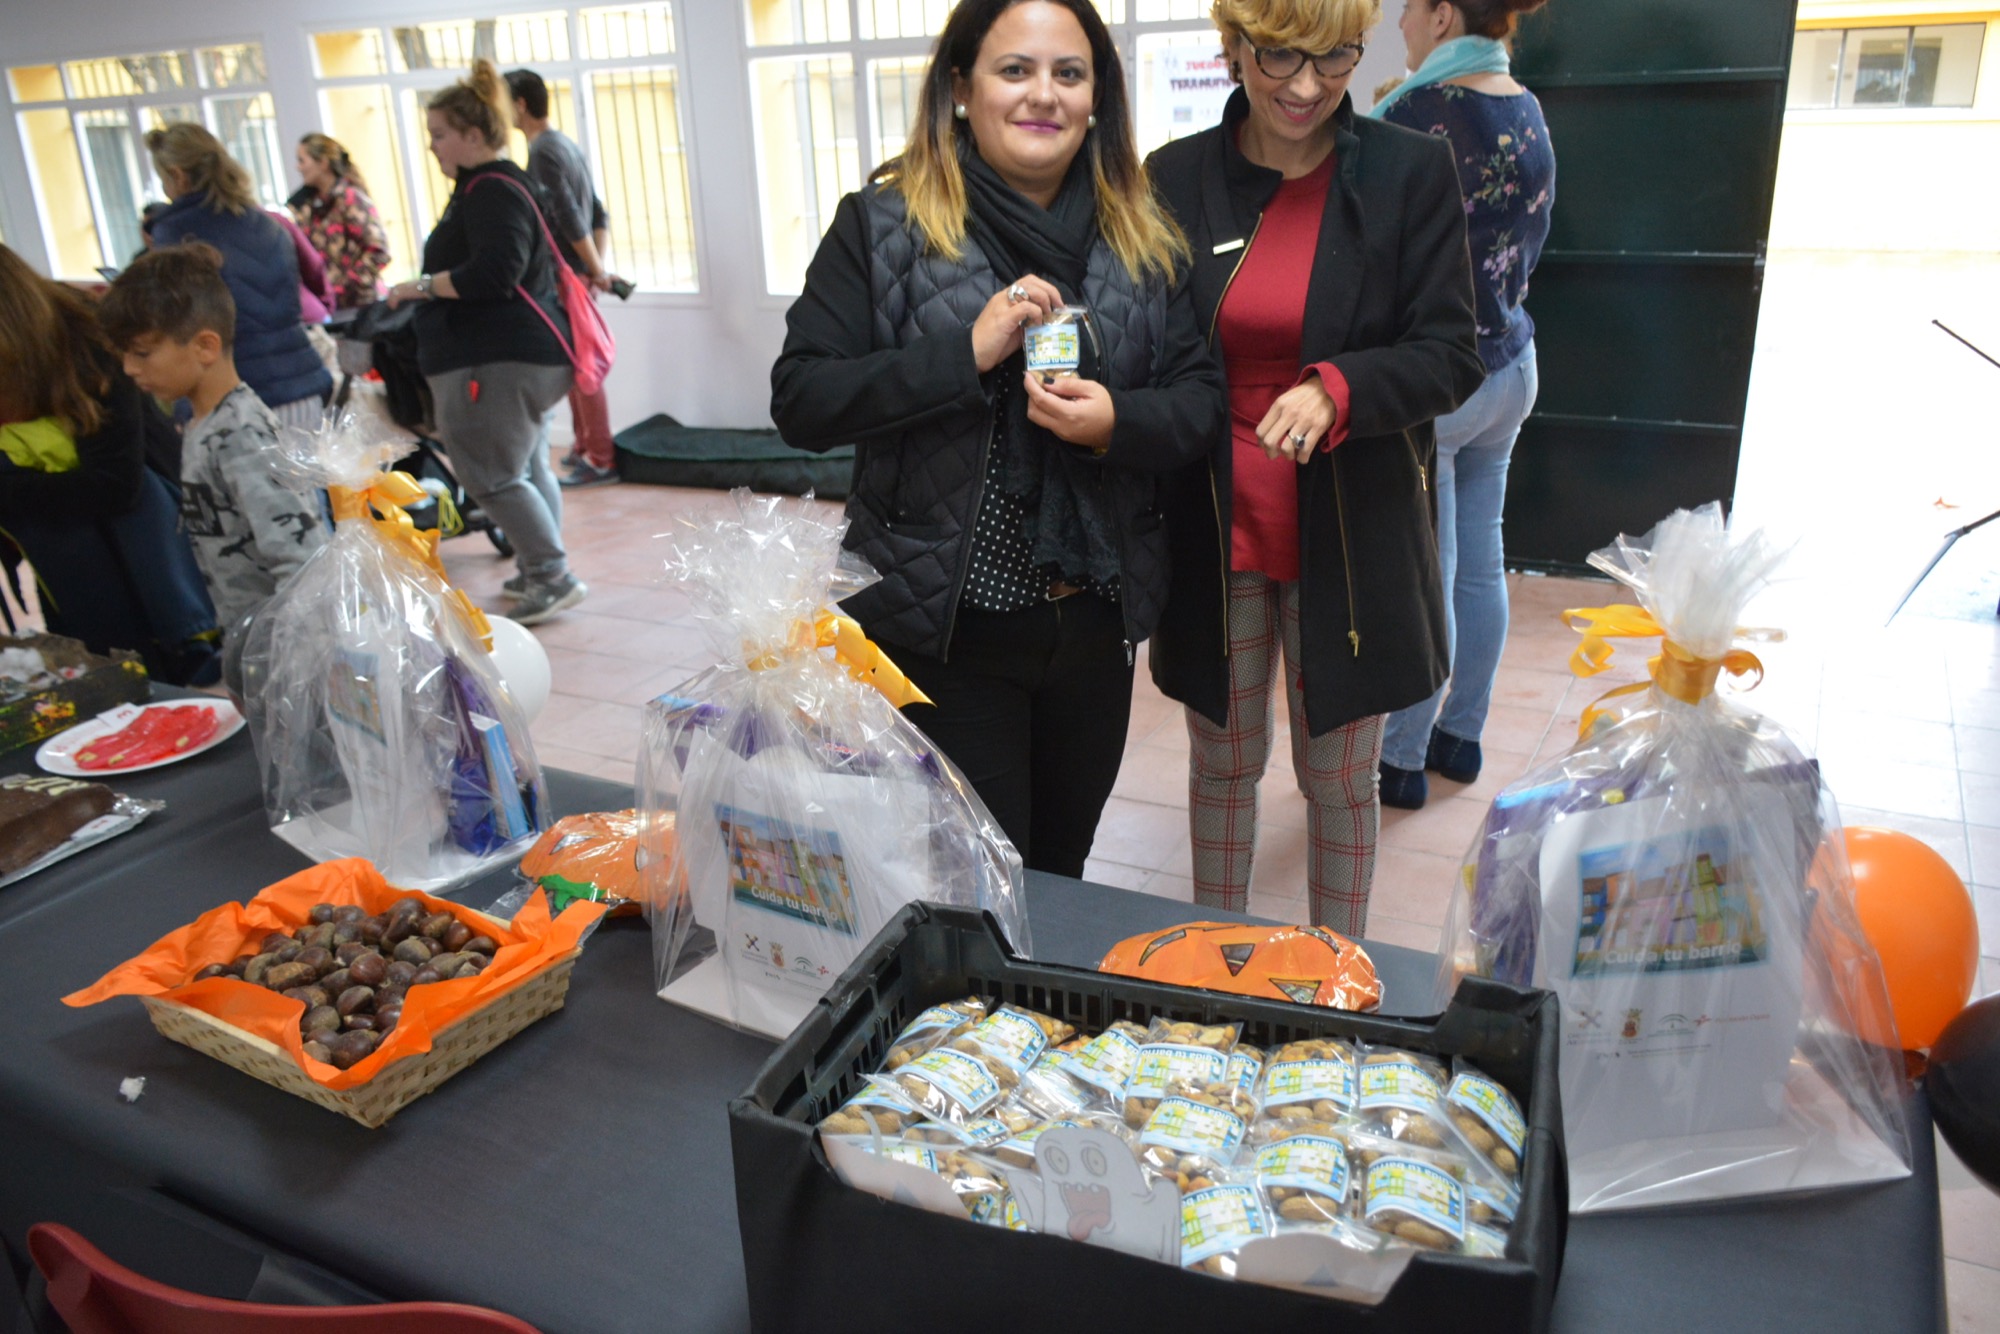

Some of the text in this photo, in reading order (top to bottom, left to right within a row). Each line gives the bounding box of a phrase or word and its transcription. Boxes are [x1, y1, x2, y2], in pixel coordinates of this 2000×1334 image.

[751, 885, 838, 921] Cuida tu baro
[1604, 940, 1742, 964] Cuida tu barrio
[1017, 1017, 1042, 1039] Cuida
[1141, 1047, 1174, 1057] barrio
[1175, 1050, 1187, 1058] tu
[1188, 1052, 1219, 1064] Cuida
[1231, 1055, 1253, 1066] Cui
[1319, 1060, 1351, 1072] Cuida
[1193, 1103, 1206, 1113] tu
[1207, 1107, 1239, 1126] Cuida
[1311, 1139, 1343, 1155] Cuida
[1407, 1163, 1421, 1173] tu
[1424, 1168, 1456, 1190] Cuida
[1196, 1187, 1249, 1201] Cuida tu
